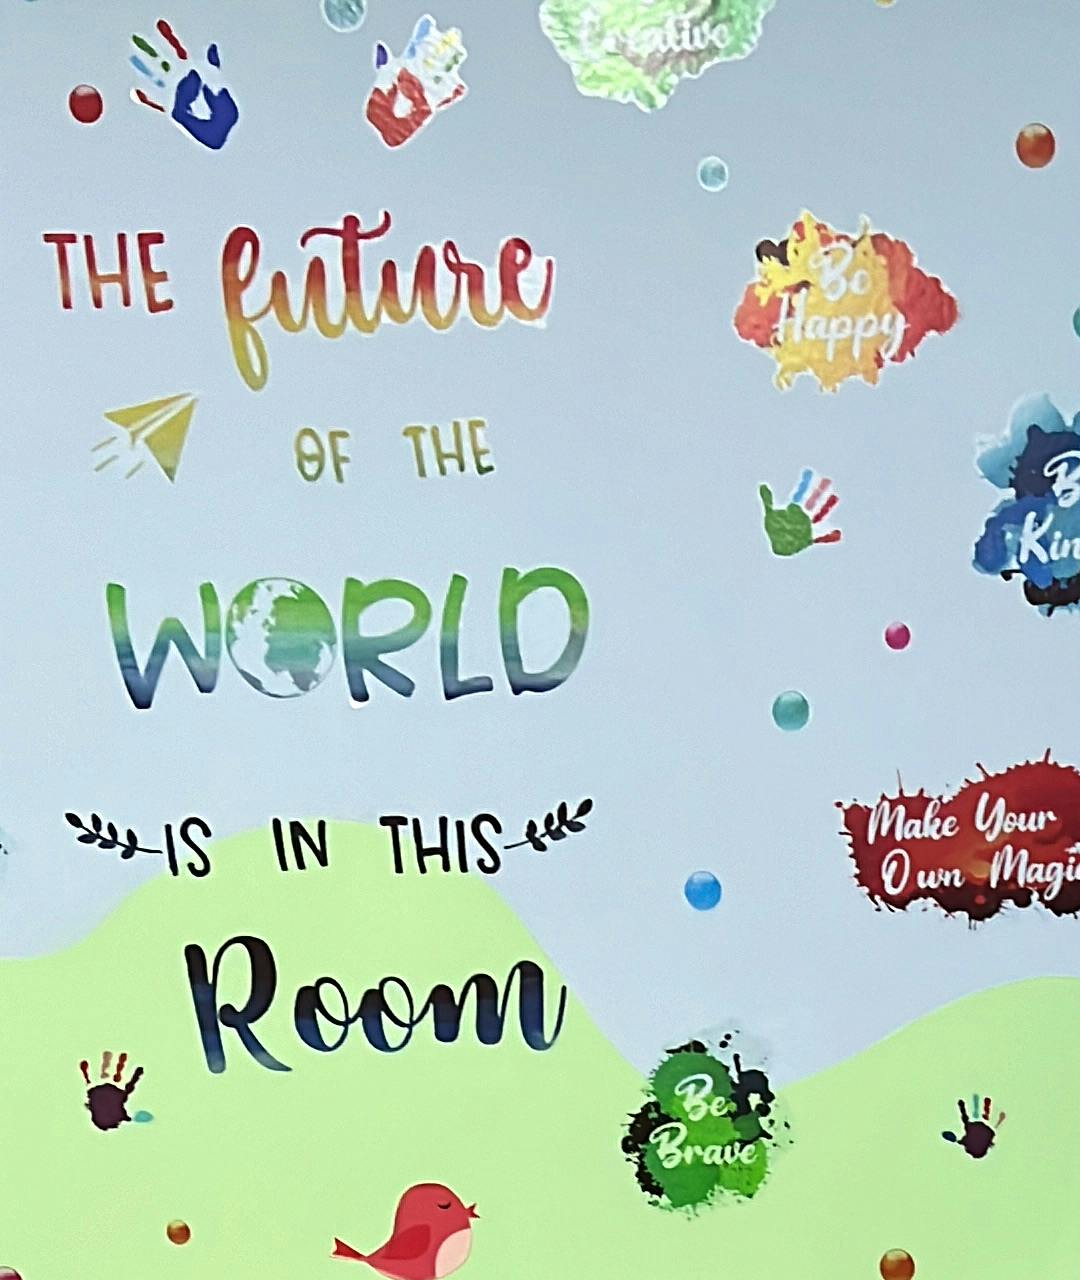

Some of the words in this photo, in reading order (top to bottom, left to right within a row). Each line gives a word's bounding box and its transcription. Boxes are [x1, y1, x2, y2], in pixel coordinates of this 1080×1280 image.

[43, 232, 174, 314] THE
[221, 210, 554, 391] future
[810, 245, 871, 299] Be
[773, 293, 907, 358] Happy
[295, 426, 350, 484] OF
[403, 419, 495, 478] THE
[106, 566, 590, 709] WORLD
[165, 817, 212, 877] IS
[273, 819, 329, 871] IN
[380, 814, 502, 874] THIS
[868, 800, 959, 845] Make
[974, 793, 1057, 841] Your
[881, 849, 964, 895] Own
[184, 936, 567, 1074] Room
[674, 1074, 729, 1121] Be
[649, 1122, 758, 1169] Brave
